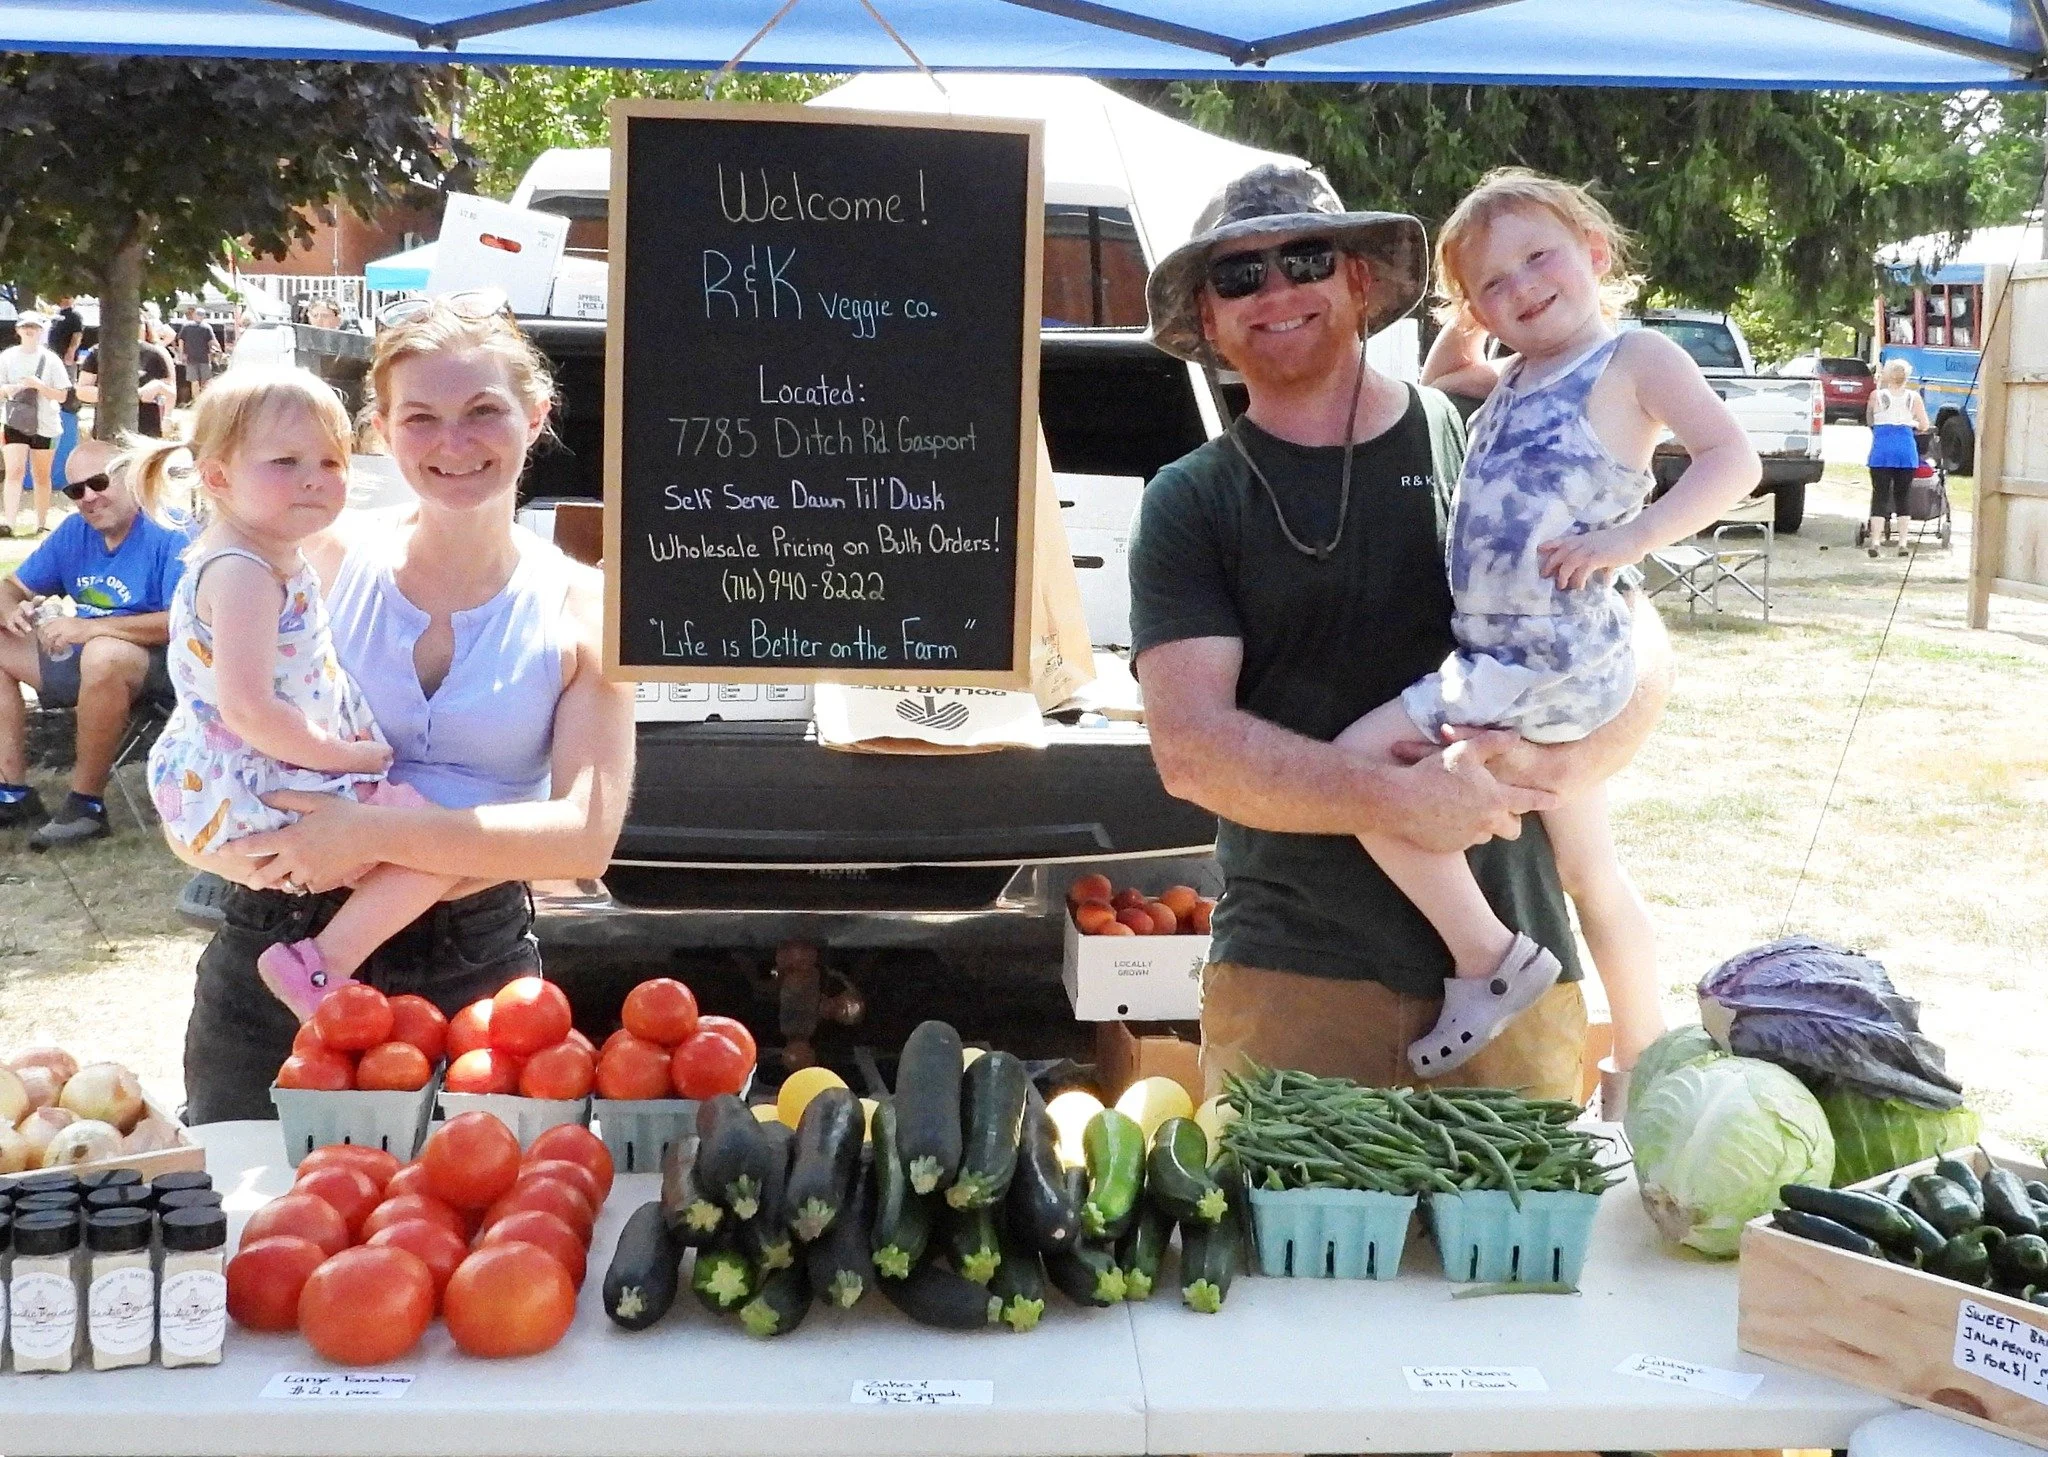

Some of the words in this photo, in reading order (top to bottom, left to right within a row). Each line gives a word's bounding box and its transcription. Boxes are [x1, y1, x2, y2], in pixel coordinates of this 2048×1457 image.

[904, 298, 938, 318] co.
[760, 364, 866, 405] Located:
[668, 417, 758, 458] 7785
[774, 417, 853, 458] Ditch
[898, 415, 977, 459] Gasport
[664, 484, 712, 511] Self
[723, 483, 780, 511] Serve
[791, 479, 847, 509] Dawn
[889, 476, 946, 511] Dusk
[648, 533, 761, 562] Wholesale
[771, 525, 834, 567] Pricing
[843, 540, 869, 556] on
[877, 524, 922, 555] Bulk
[928, 516, 1001, 554] Orders!
[722, 638, 740, 657] is
[751, 617, 823, 659] Better
[916, 686, 1007, 696] DOLLAR
[1113, 960, 1153, 968] LOCALLY
[1965, 1305, 2020, 1333] SWEET
[1963, 1326, 2041, 1363] JALAPENOS
[1965, 1348, 1976, 1362] 3
[283, 1374, 331, 1385] Large
